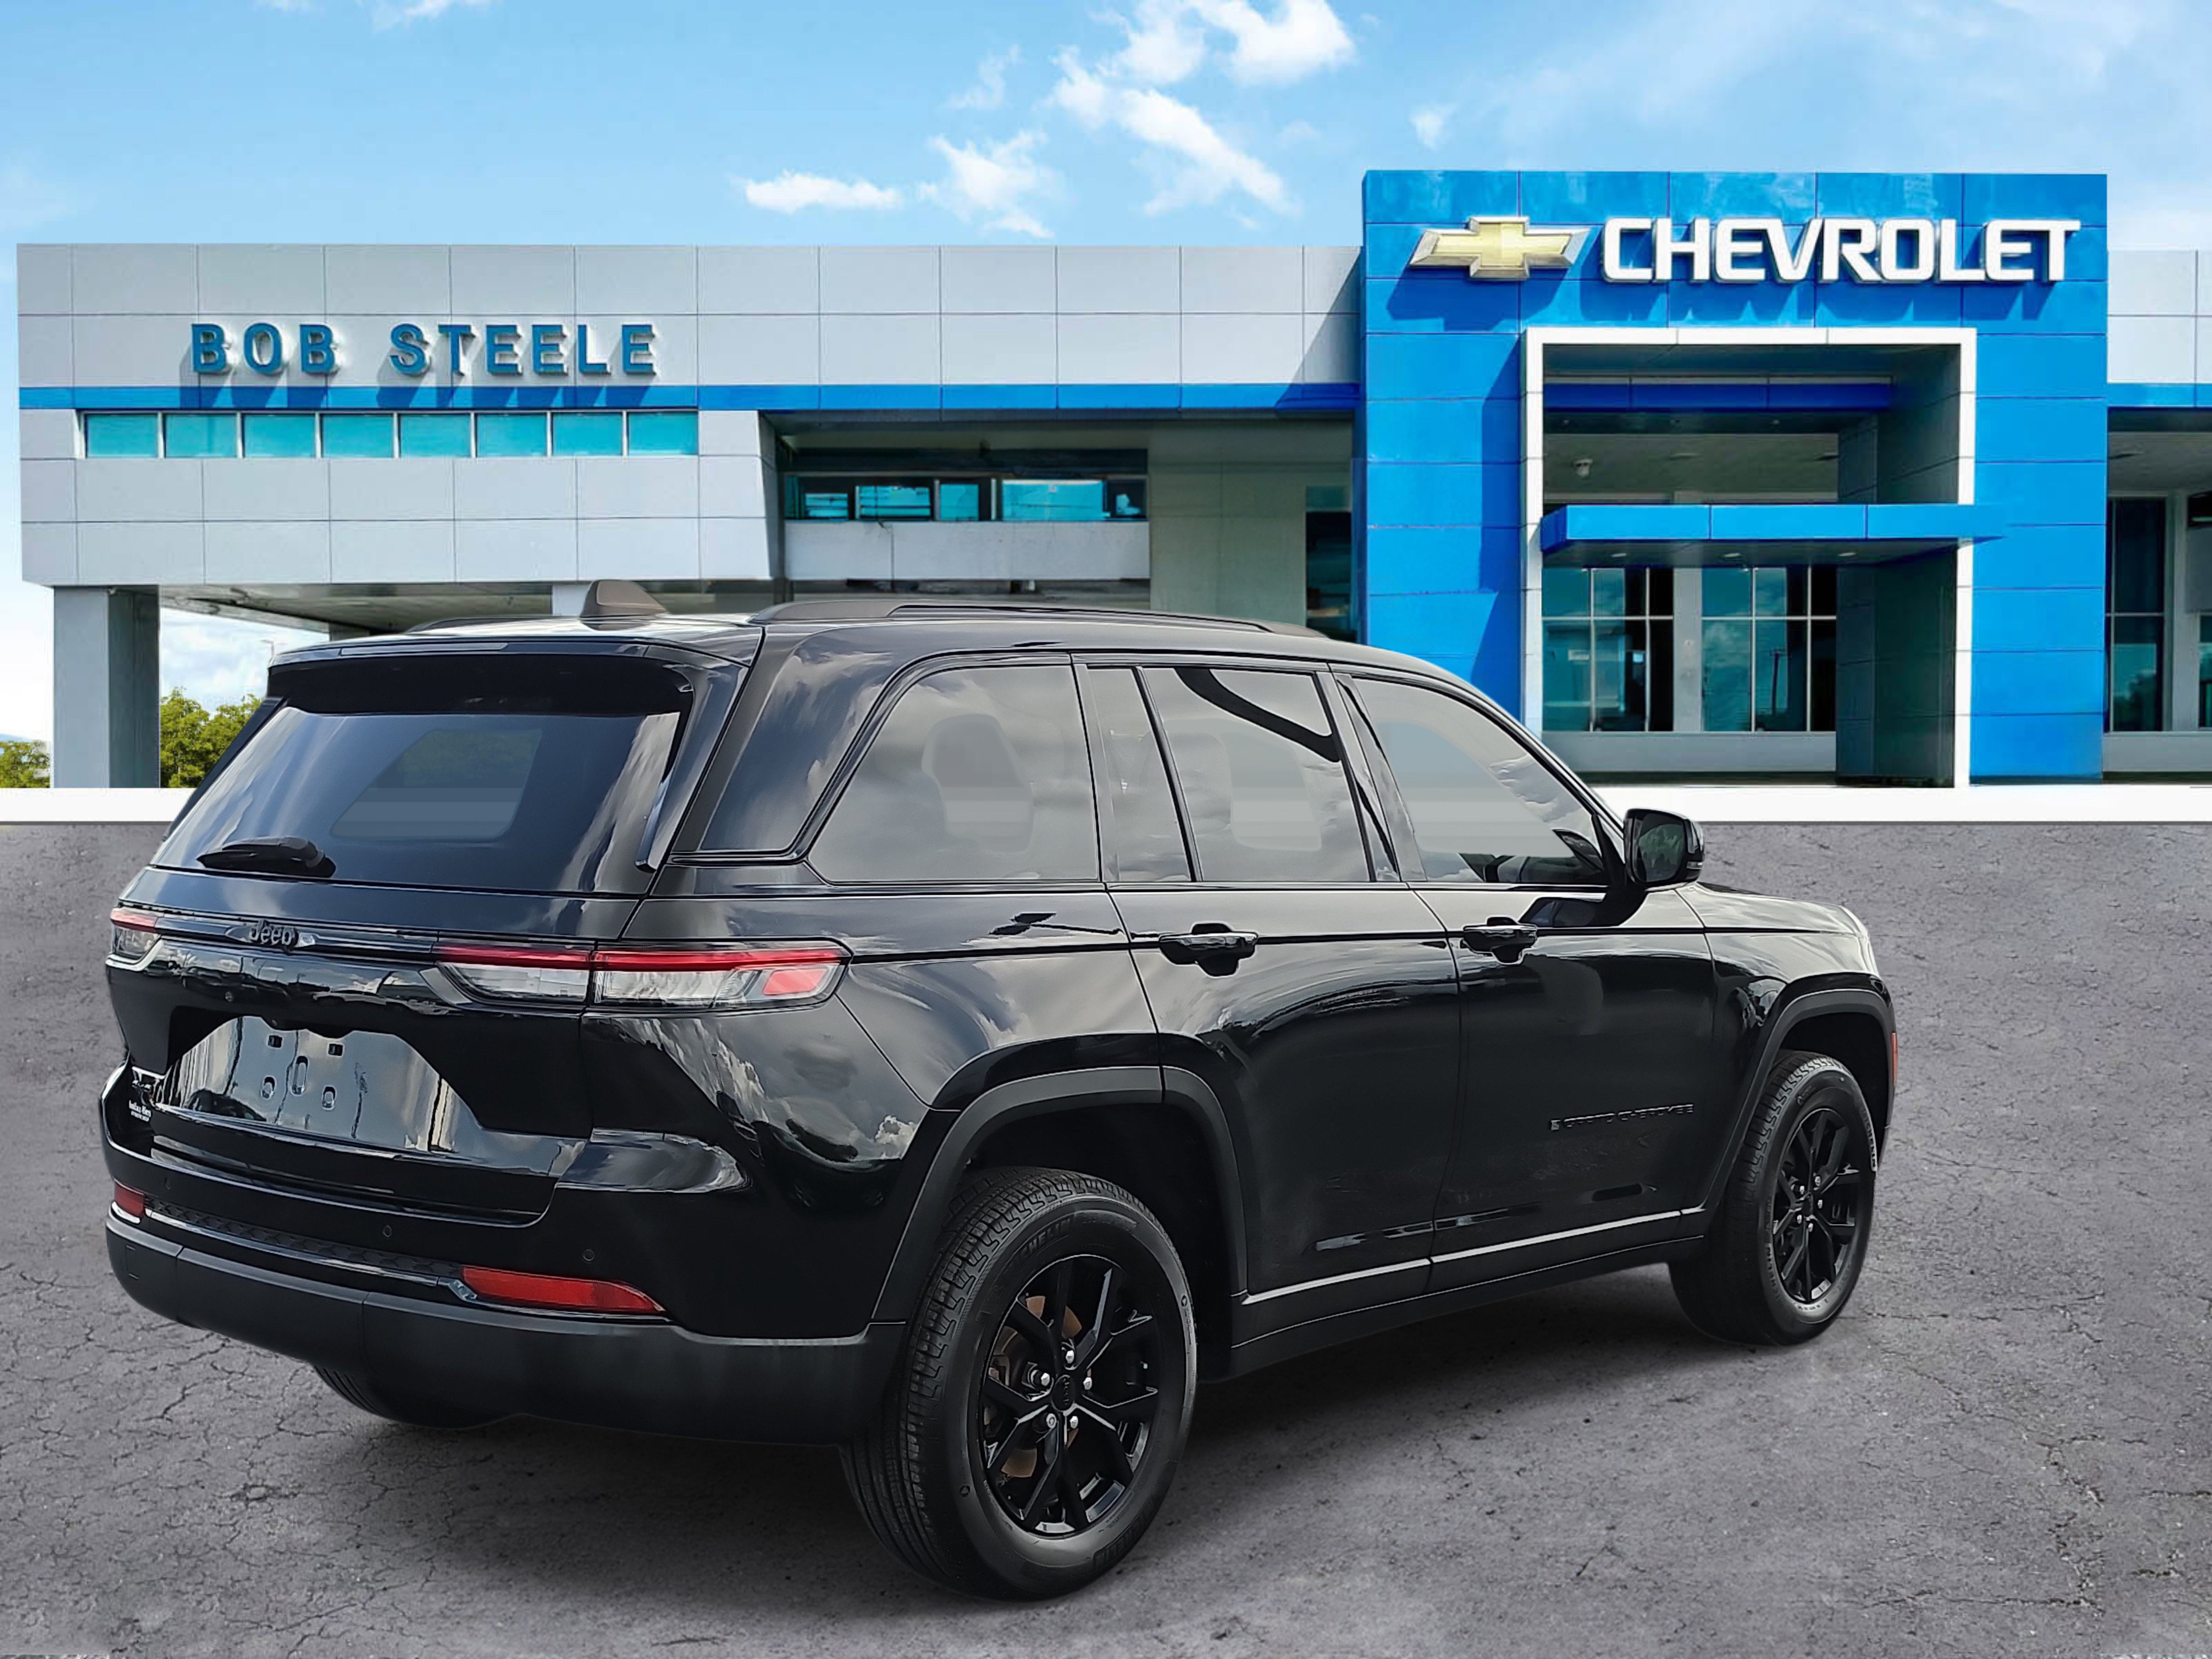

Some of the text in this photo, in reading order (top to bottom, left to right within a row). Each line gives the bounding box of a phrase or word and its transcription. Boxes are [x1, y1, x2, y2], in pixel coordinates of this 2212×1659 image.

[1602, 218, 2081, 284] CHEVROLET
[191, 322, 656, 376] BOB STEELE
[248, 919, 296, 946] Jeep
